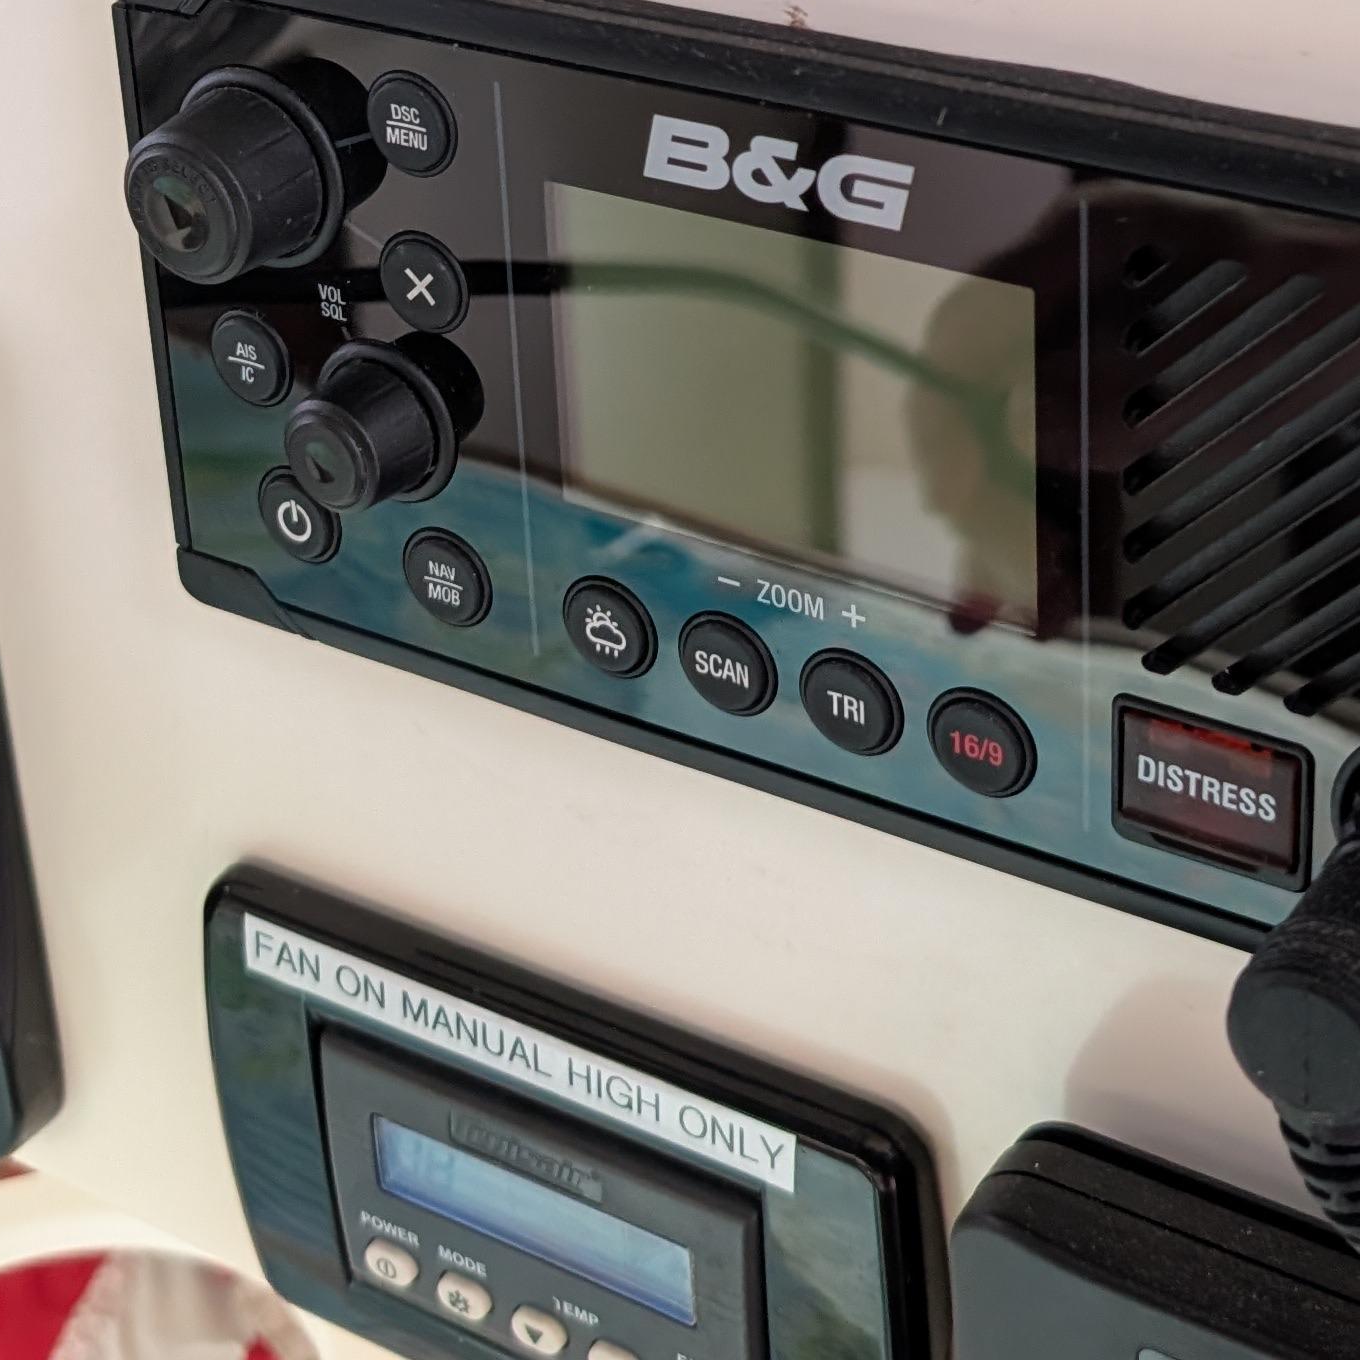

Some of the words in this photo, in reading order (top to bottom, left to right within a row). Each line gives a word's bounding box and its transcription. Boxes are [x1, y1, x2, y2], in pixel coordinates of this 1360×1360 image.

[389, 102, 421, 126] DSC
[385, 127, 428, 152] MENU
[642, 113, 916, 232] B&G
[317, 283, 347, 307] VOL
[320, 301, 348, 322] SQL
[235, 341, 257, 362] AIS
[241, 364, 255, 384] IC
[428, 559, 456, 583] NAV
[427, 583, 461, 607] MOB
[756, 577, 826, 623] ZOOM
[694, 649, 751, 690] SCAN
[826, 689, 867, 727] TRI
[948, 729, 1005, 769] 16/9
[1136, 752, 1278, 824] DISTRESS
[253, 928, 322, 984] FAN
[335, 963, 387, 1010] ON
[401, 988, 552, 1078] MANUAL
[566, 1056, 662, 1124] HIGH
[678, 1106, 786, 1171] ONLY
[359, 1209, 420, 1247] POWER
[437, 1244, 488, 1278] MODE
